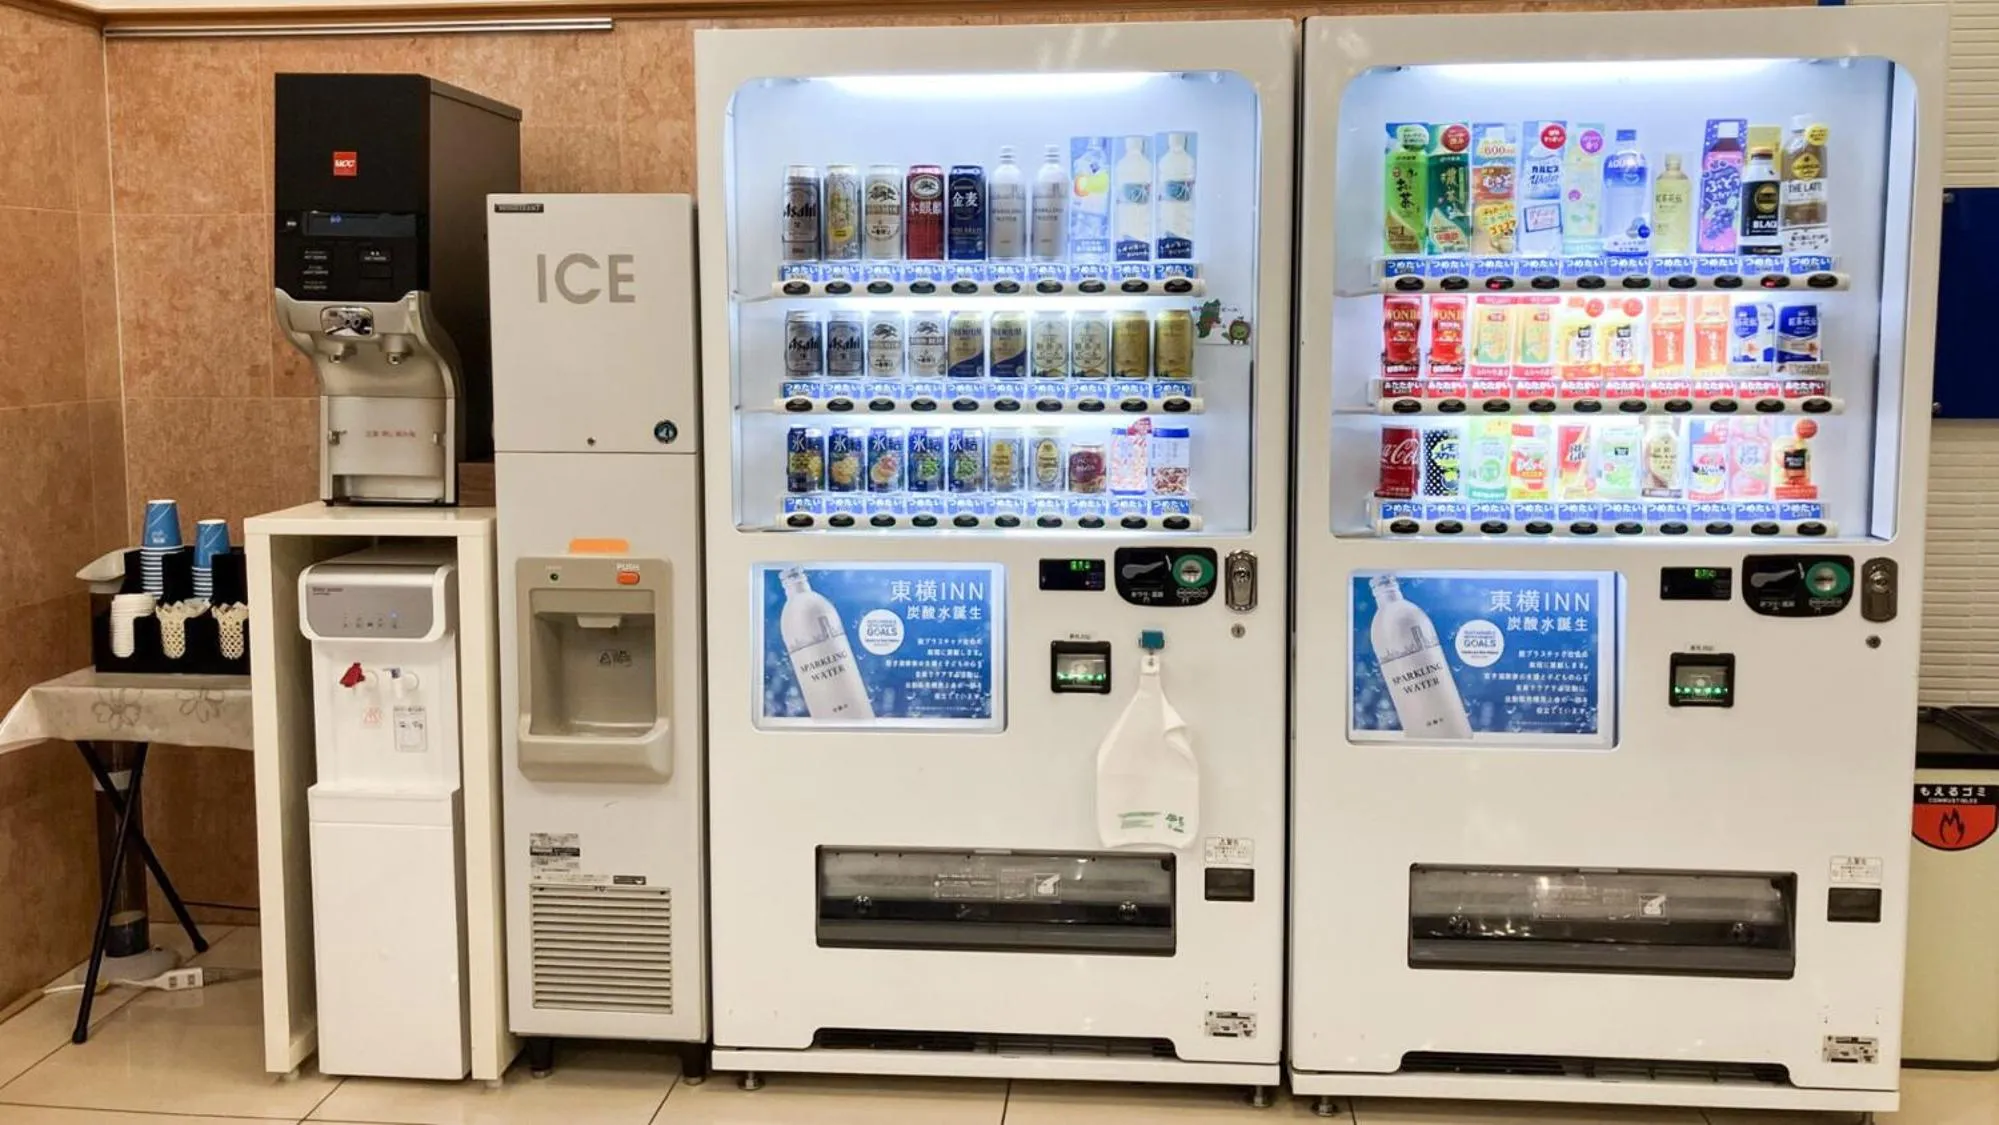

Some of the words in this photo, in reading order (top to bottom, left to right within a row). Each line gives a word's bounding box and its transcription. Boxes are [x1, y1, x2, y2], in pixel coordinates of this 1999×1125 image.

[952, 192, 977, 207] 金麦
[784, 202, 816, 217] Asahi
[537, 253, 636, 305] ICE
[789, 336, 818, 350] Asahi
[829, 336, 860, 350] Asahi
[1384, 503, 1421, 511] つめたい
[1428, 503, 1466, 511] つめたい
[1472, 503, 1510, 511] つめたい
[1516, 503, 1554, 511] つめたい
[1560, 503, 1598, 511] つめたい
[1604, 504, 1642, 512] つめたい
[1649, 504, 1686, 512] つめたい
[1693, 504, 1731, 512] つめたい
[1738, 504, 1776, 512] つめたい
[1782, 504, 1819, 512] つめたい
[890, 579, 984, 602] 東横INN
[1490, 589, 1590, 613] 東横INN
[907, 605, 982, 620] 炭酸水誕生
[1507, 617, 1588, 632] 炭酸水誕生
[867, 628, 897, 636] GOALS
[1464, 640, 1496, 648] GOALS
[800, 651, 847, 672] SPARKLING
[811, 664, 845, 682] WATER
[1392, 663, 1442, 684] SPARKLING
[1403, 677, 1440, 694] WATER
[1920, 786, 1986, 797] もえるゴミ
